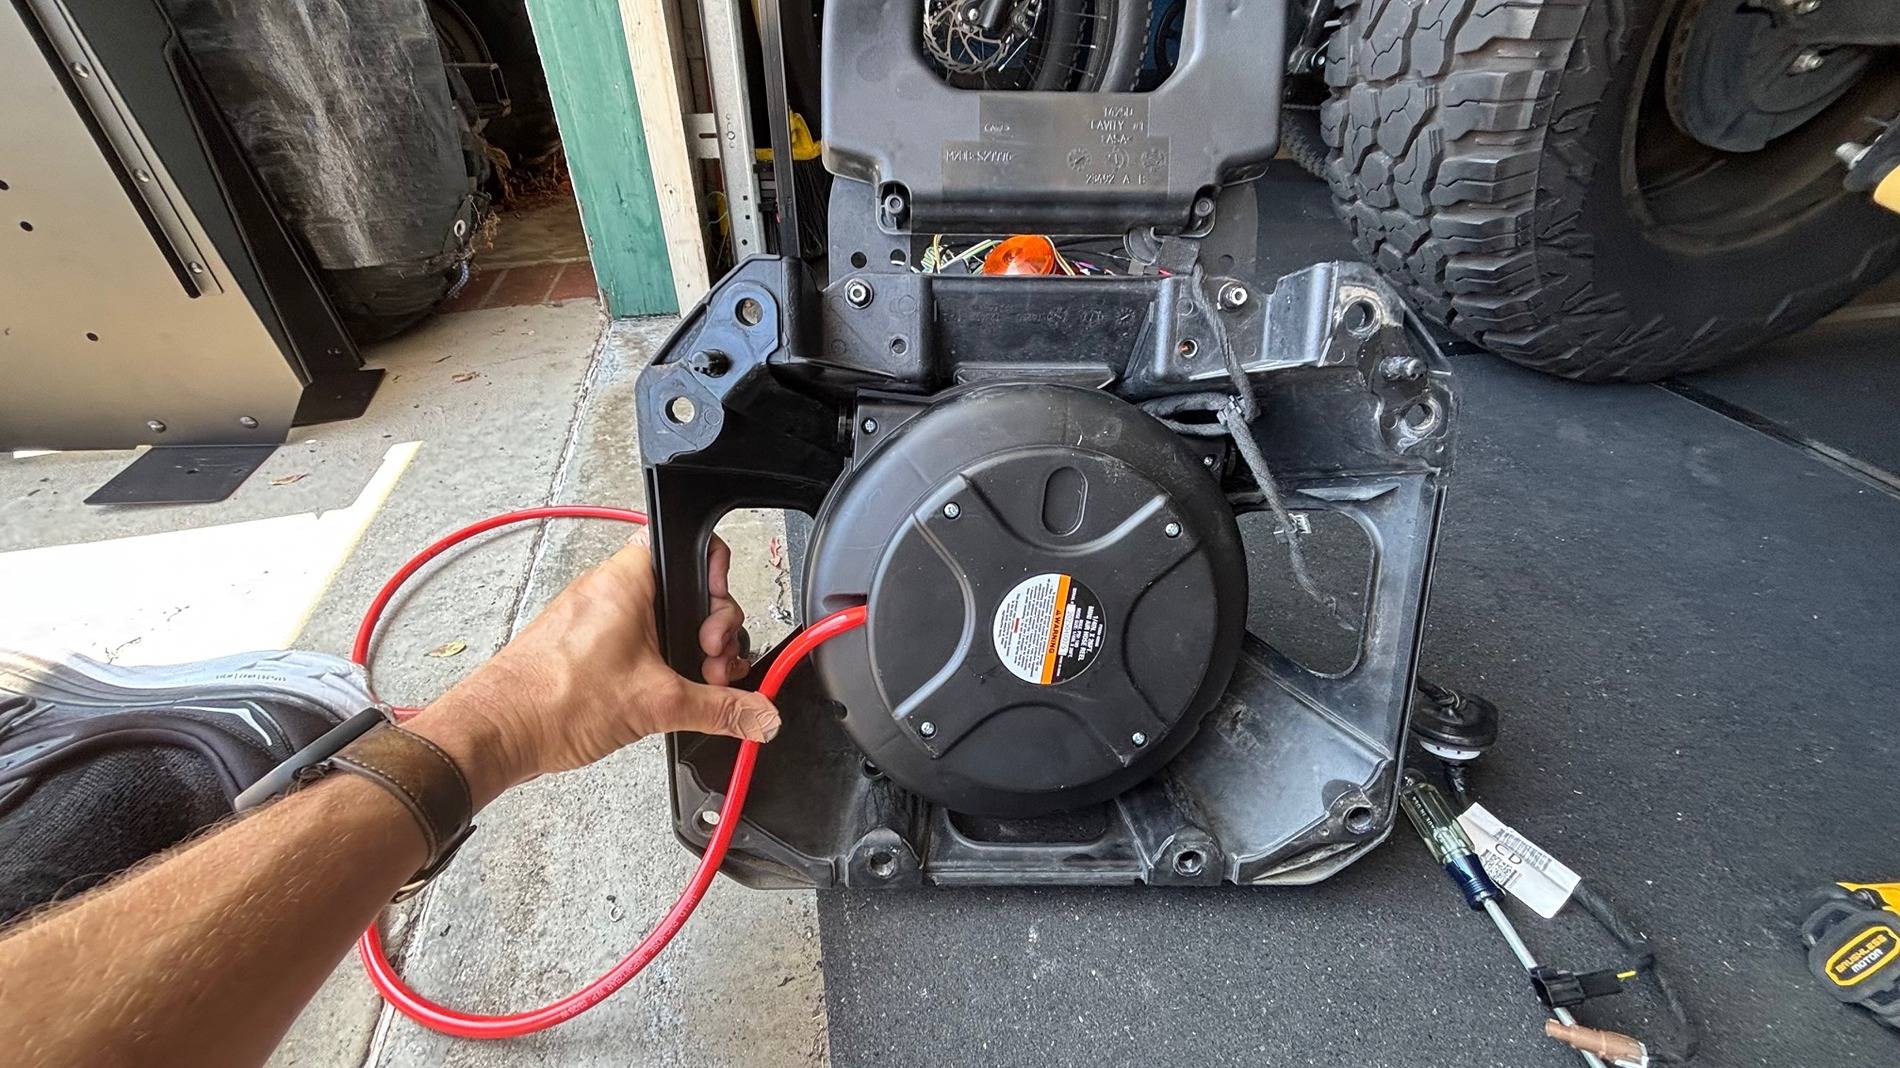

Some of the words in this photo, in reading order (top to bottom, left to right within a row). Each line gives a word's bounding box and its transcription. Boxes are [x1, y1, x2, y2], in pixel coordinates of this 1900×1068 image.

[1049, 617, 1062, 654] WARNING
[1834, 934, 1887, 973] BRUSHLESS
[1851, 948, 1883, 973] MOTOR
